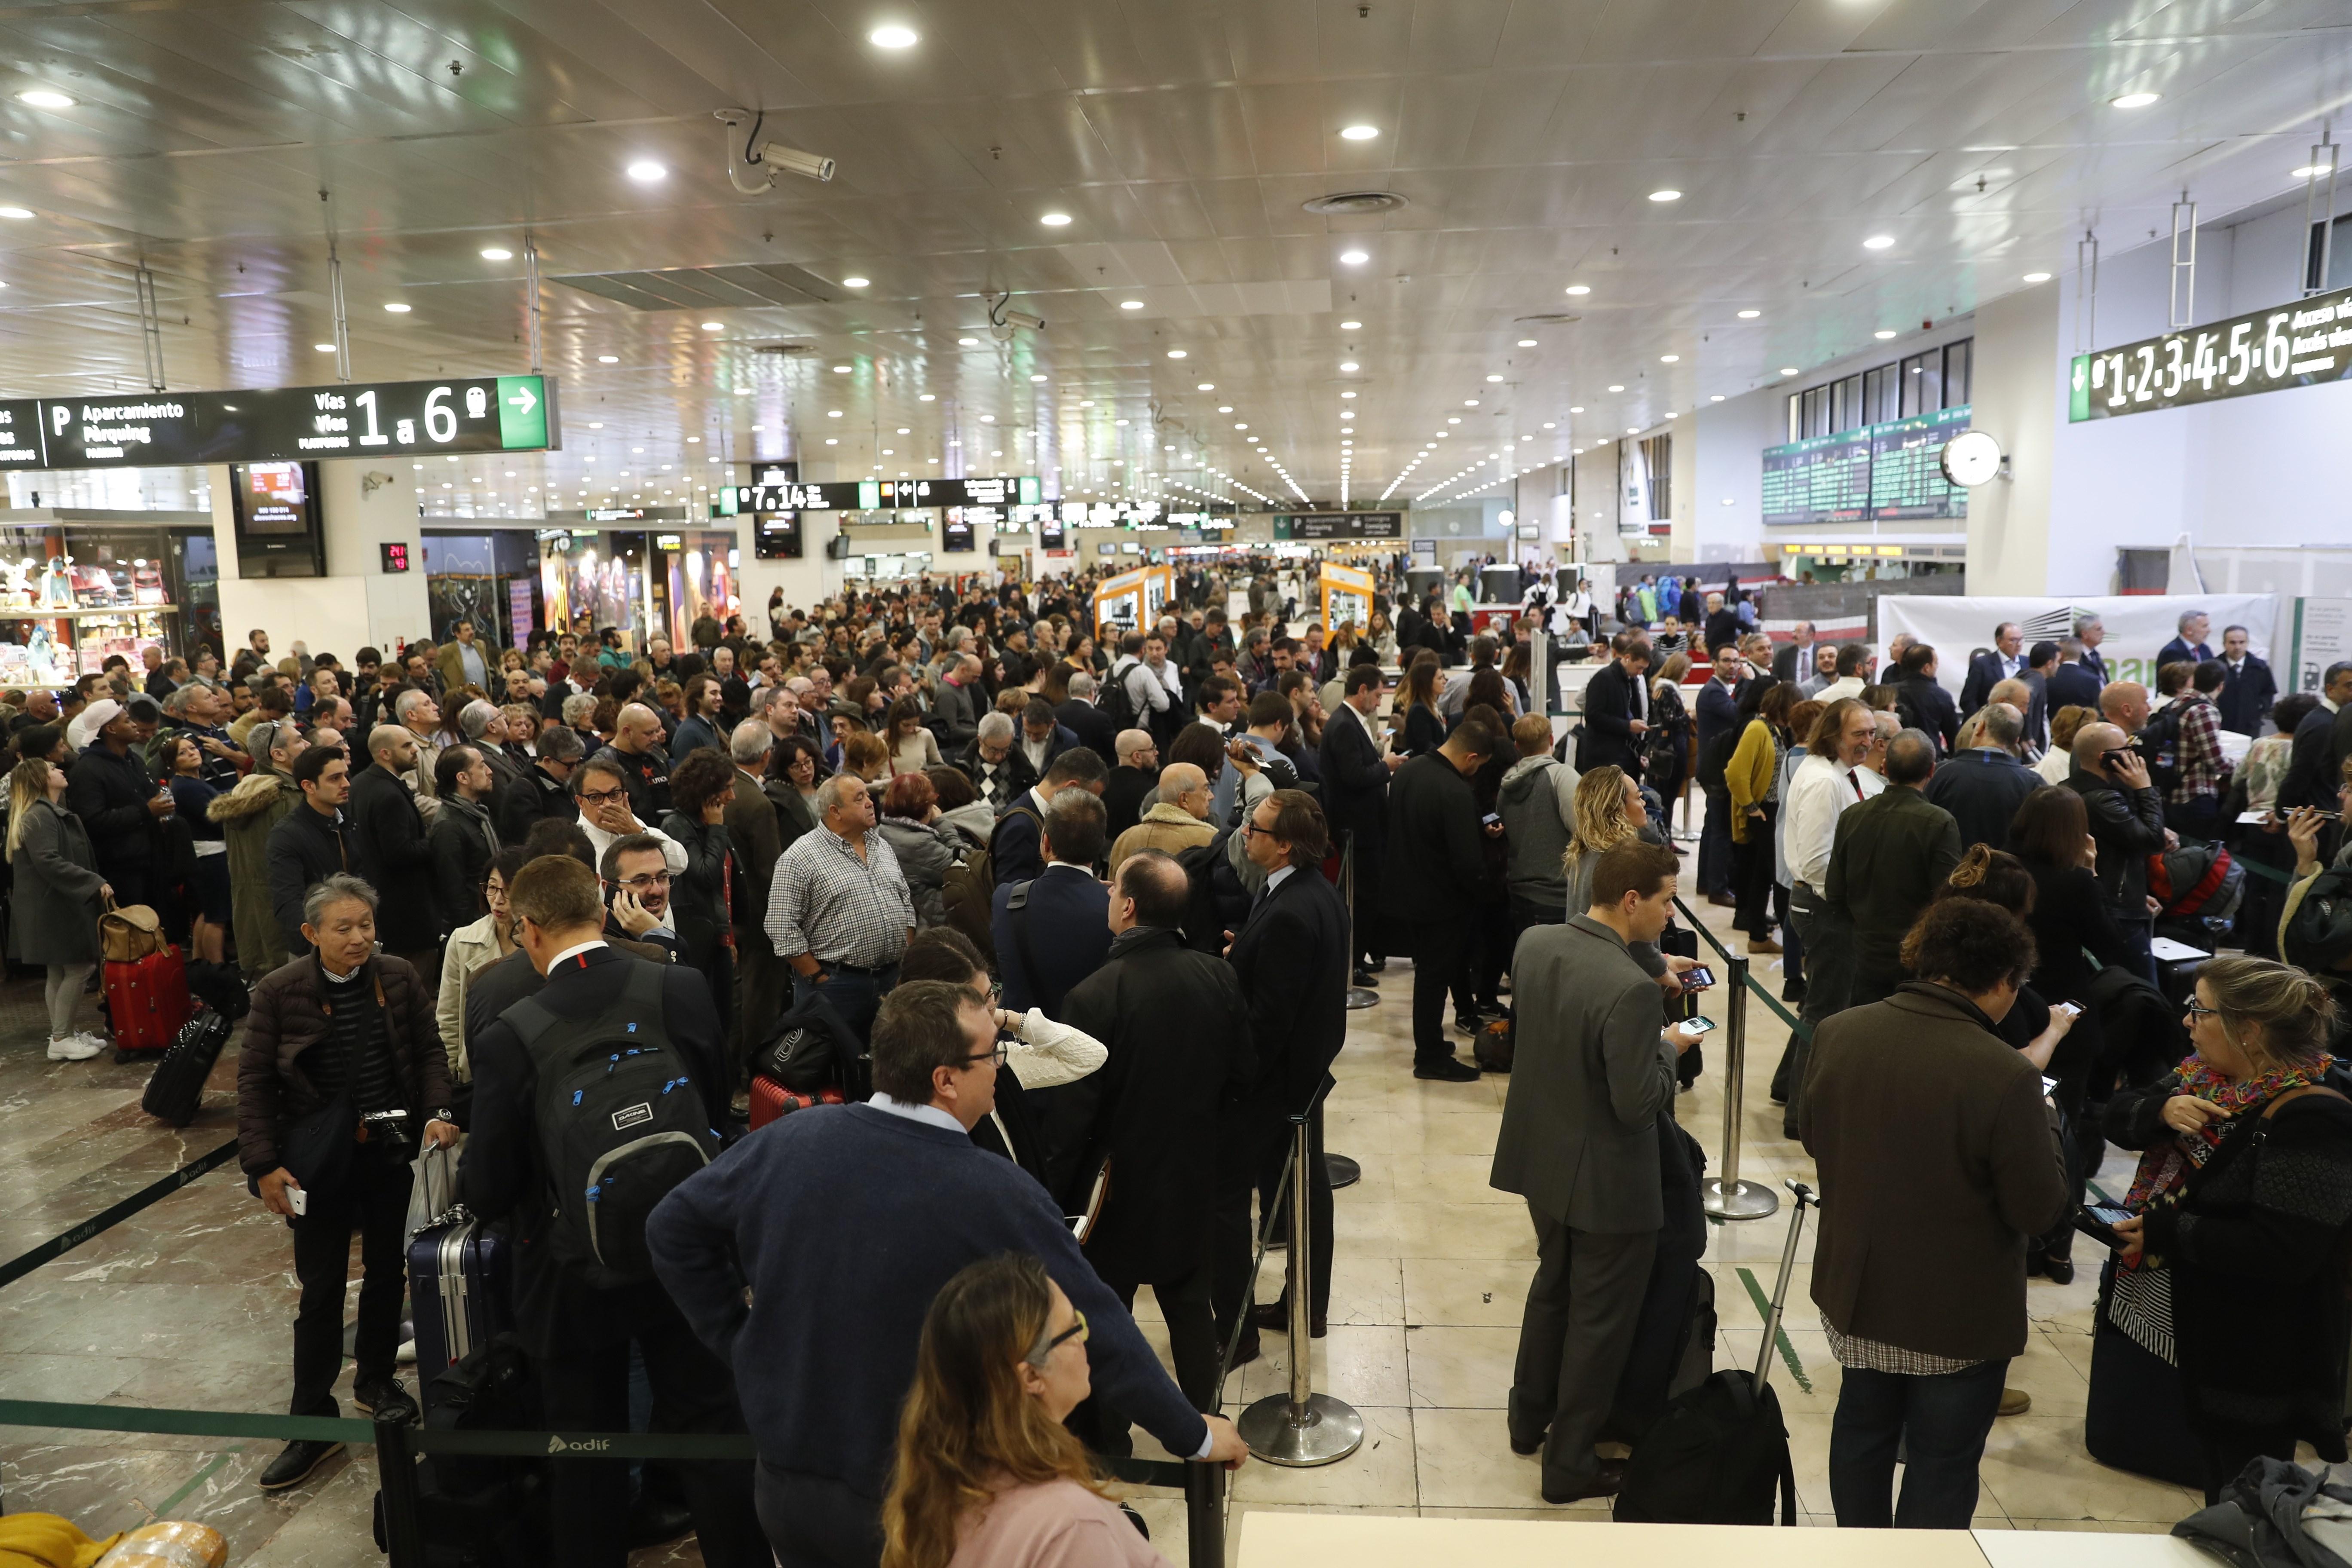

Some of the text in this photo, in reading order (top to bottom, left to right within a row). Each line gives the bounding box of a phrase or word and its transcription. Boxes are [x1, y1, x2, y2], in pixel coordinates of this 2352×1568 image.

[2291, 310, 2335, 330] Acceso
[2291, 330, 2328, 355] Accés
[314, 392, 346, 410] Vías
[52, 402, 184, 436] P Aparcamiento
[315, 413, 349, 432] Vies
[356, 386, 457, 445] 1 a 6
[83, 423, 151, 444] Pàrquing
[778, 485, 807, 509] 14
[619, 1109, 647, 1121] DAKINE
[570, 1439, 610, 1451] adif
